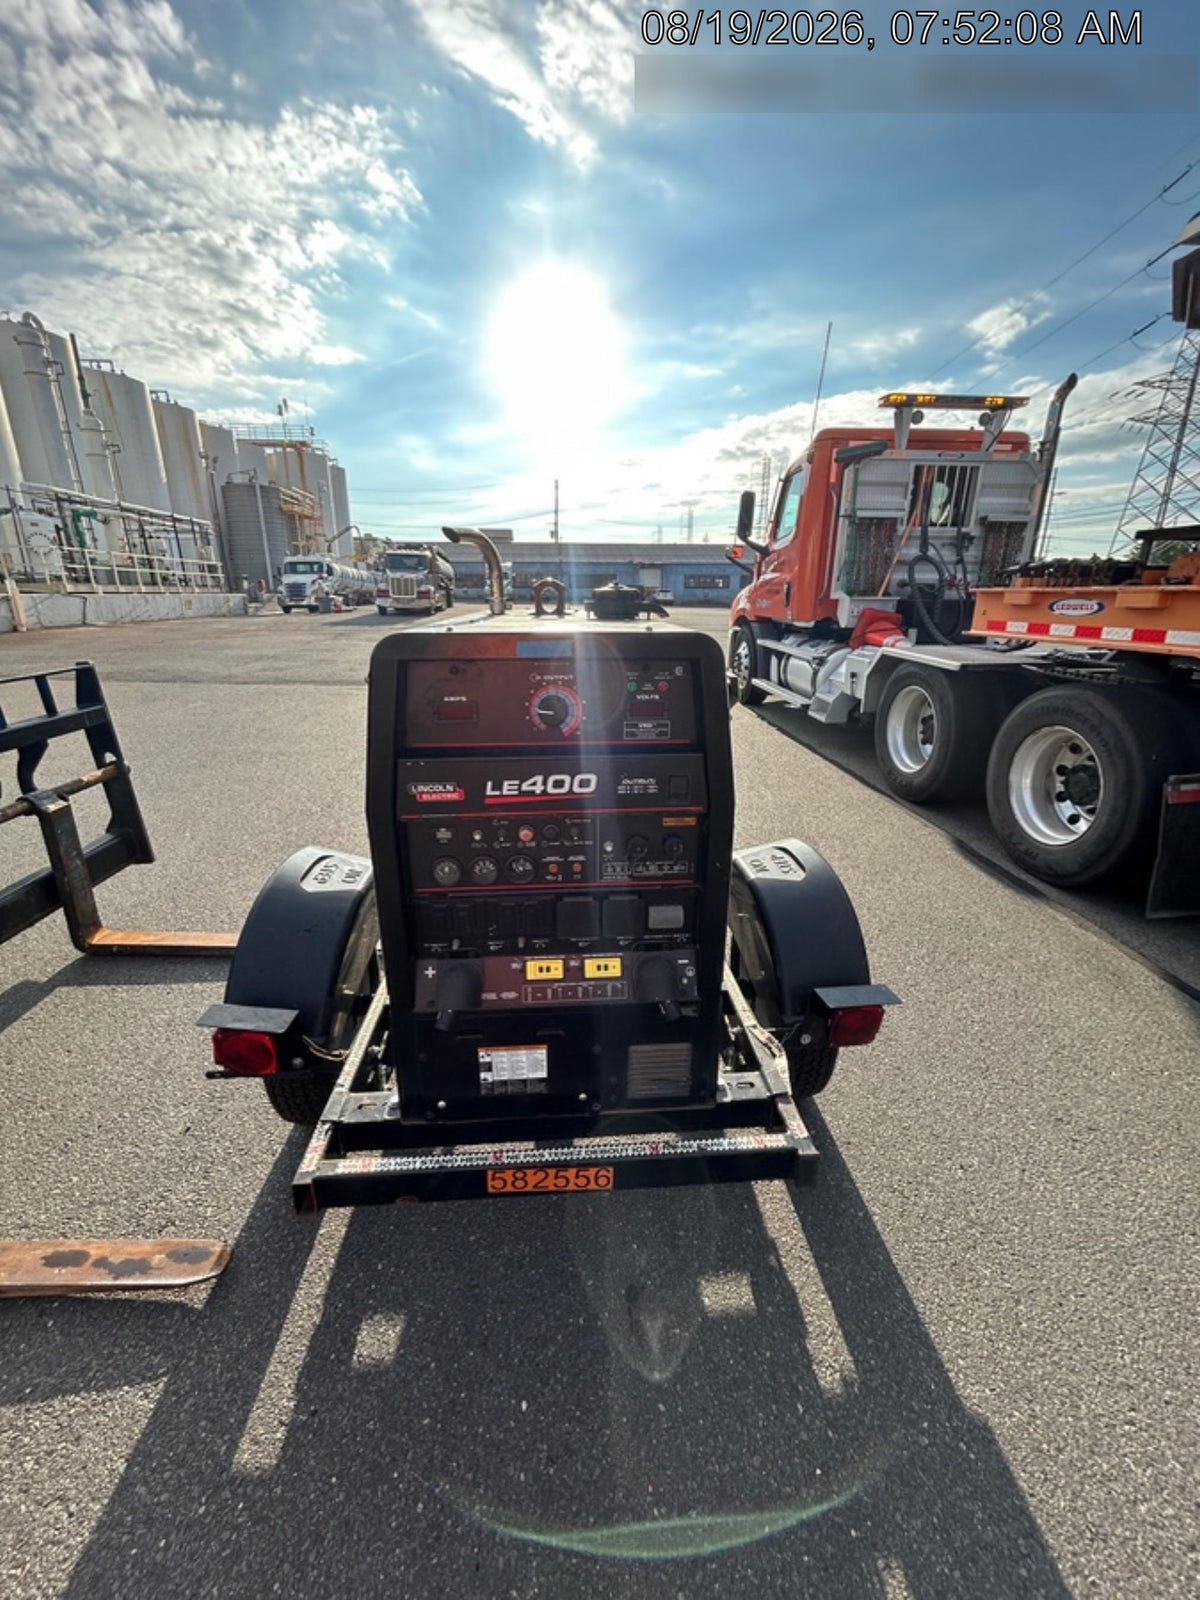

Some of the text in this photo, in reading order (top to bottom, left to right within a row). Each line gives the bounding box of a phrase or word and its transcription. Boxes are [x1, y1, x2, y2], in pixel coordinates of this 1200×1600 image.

[411, 784, 455, 793] LINCOLN
[486, 773, 598, 795] LE400
[489, 1167, 613, 1192] 582556
